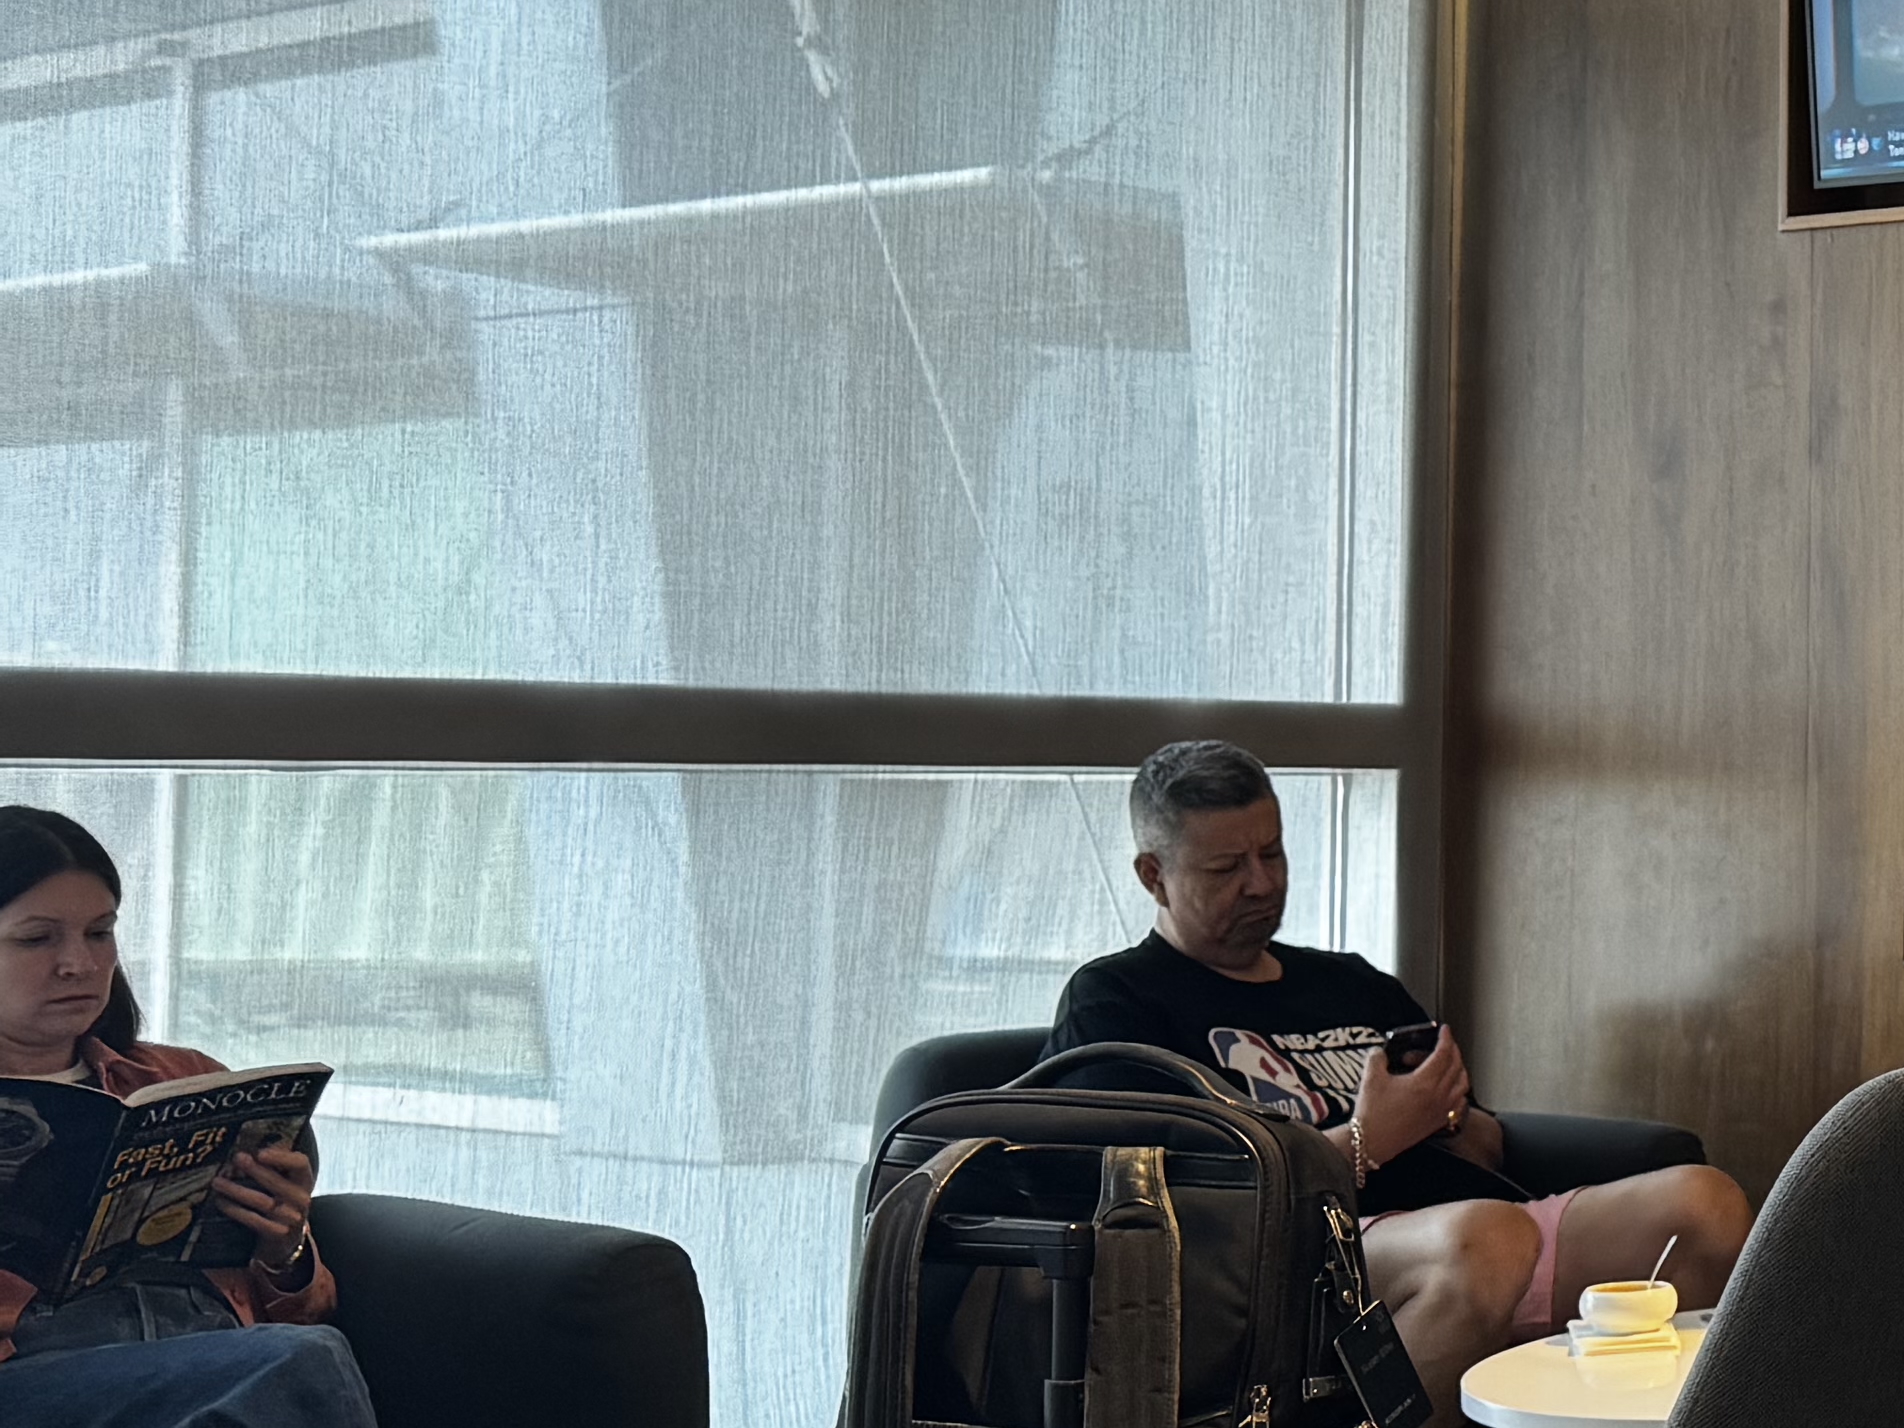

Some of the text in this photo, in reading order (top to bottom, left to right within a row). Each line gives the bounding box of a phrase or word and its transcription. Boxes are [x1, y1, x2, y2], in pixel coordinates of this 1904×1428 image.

[141, 1079, 311, 1128] MONOCLE
[106, 1144, 215, 1189] or Fun?
[113, 1138, 178, 1171] Fast,
[188, 1127, 229, 1151] Fit
